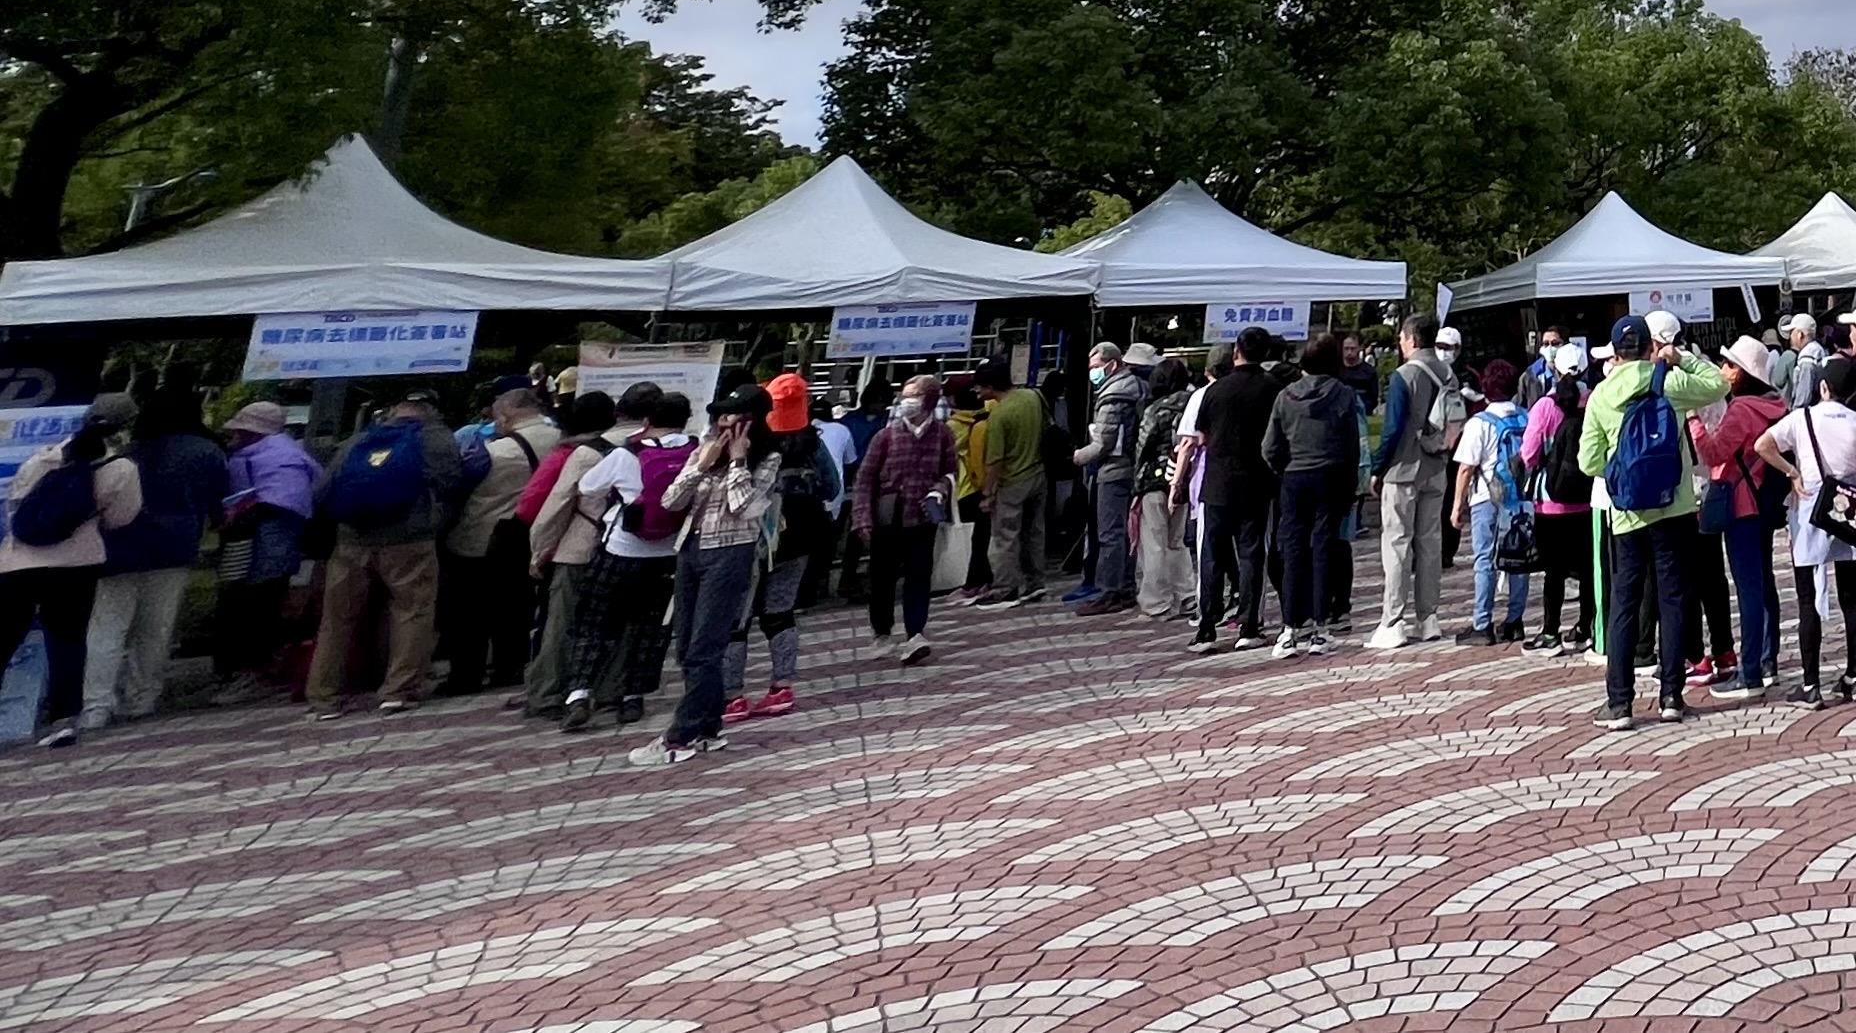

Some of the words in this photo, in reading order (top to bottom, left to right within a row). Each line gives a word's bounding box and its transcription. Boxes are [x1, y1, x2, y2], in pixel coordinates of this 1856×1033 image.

[1223, 307, 1294, 323] 免費測血糖
